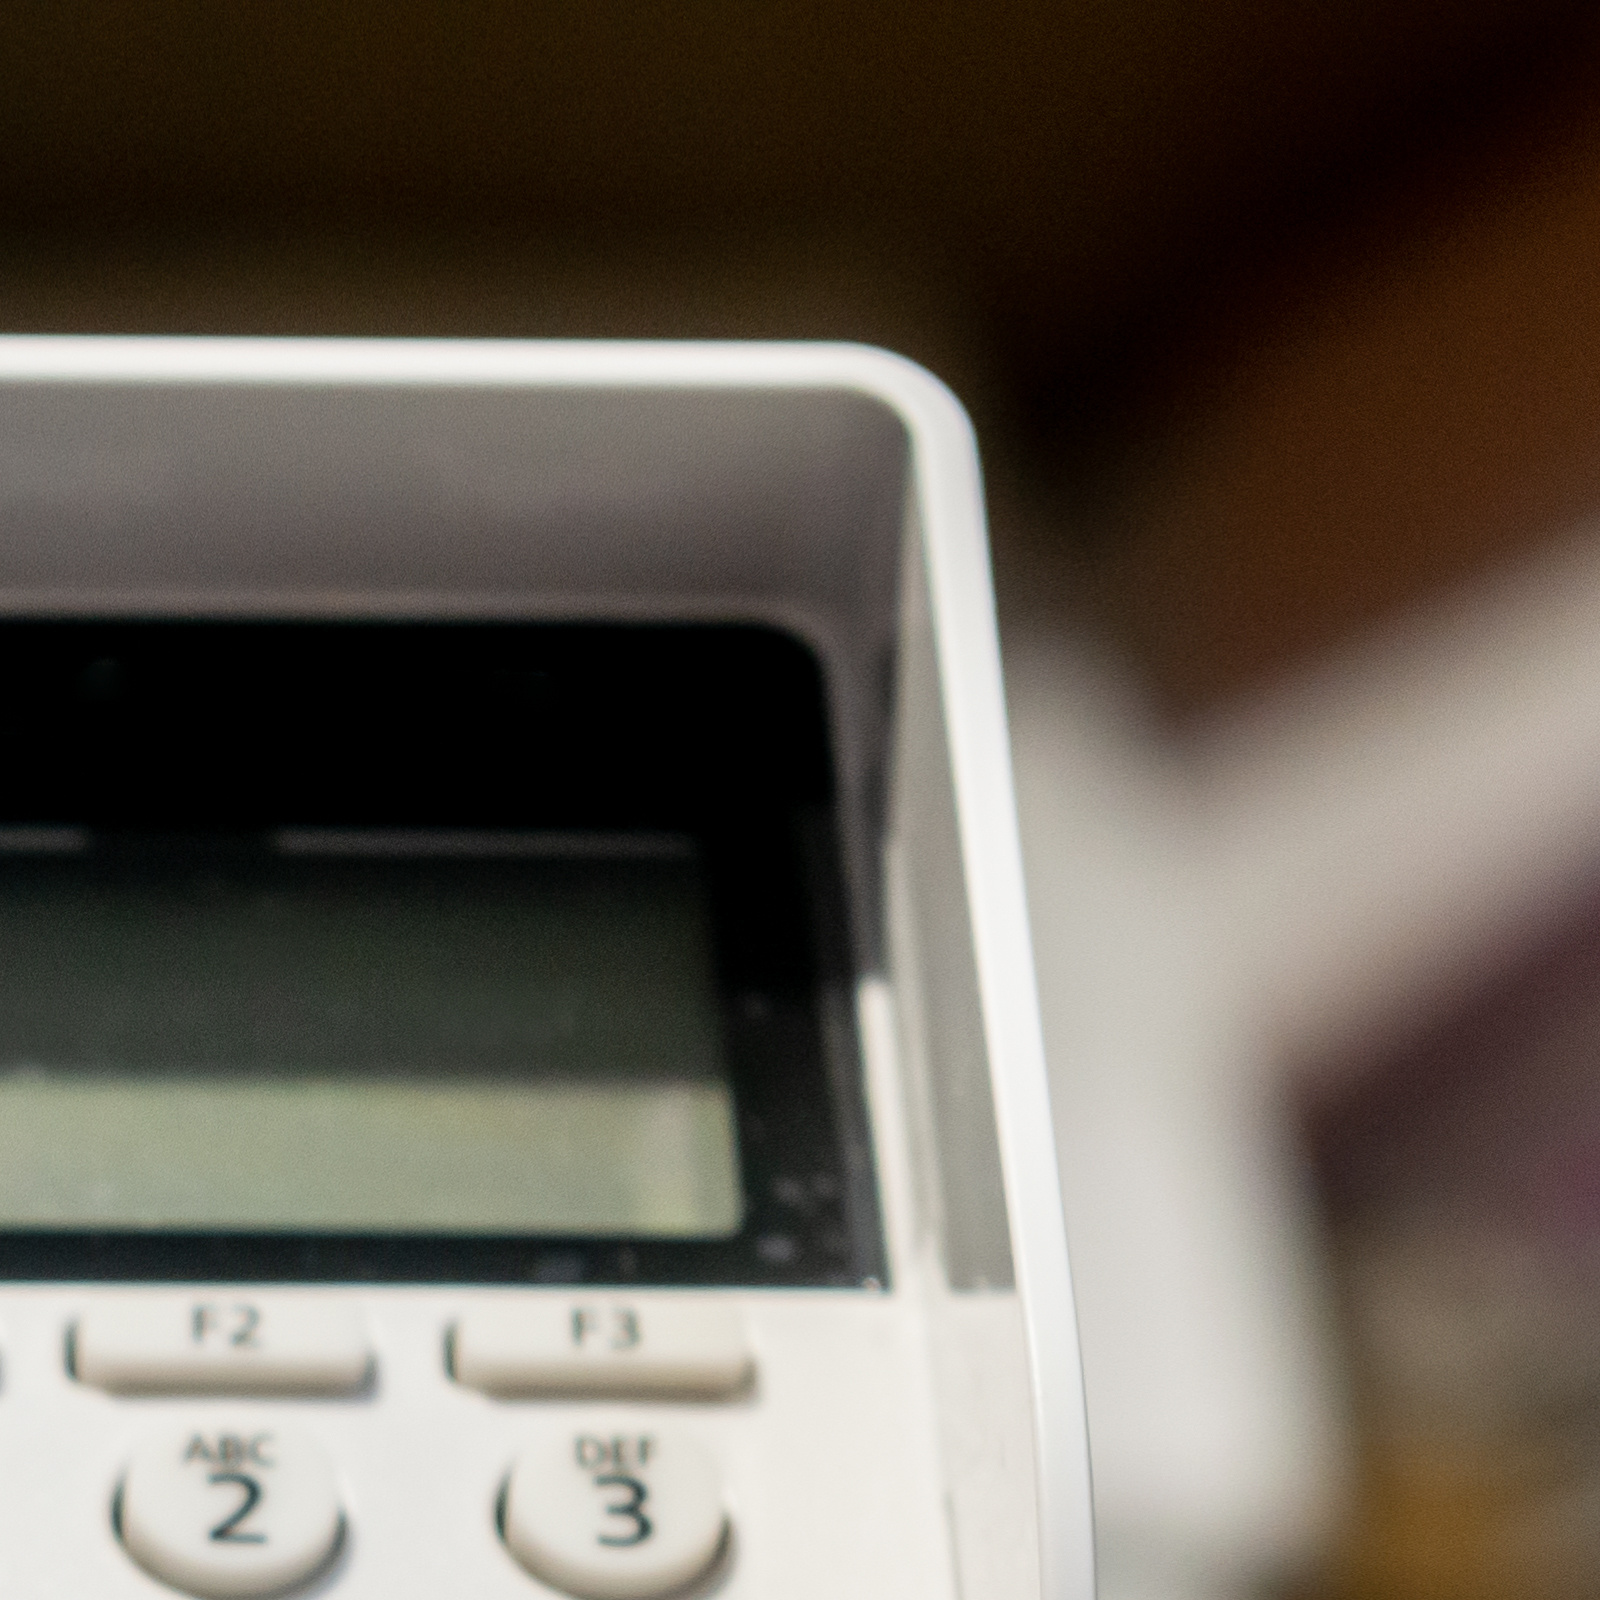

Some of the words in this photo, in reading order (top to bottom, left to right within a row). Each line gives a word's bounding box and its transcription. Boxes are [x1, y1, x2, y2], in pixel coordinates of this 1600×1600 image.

[182, 1432, 273, 1468] ABC
[574, 1433, 656, 1470] DEF
[208, 1469, 268, 1545] 2
[594, 1471, 655, 1548] 3
